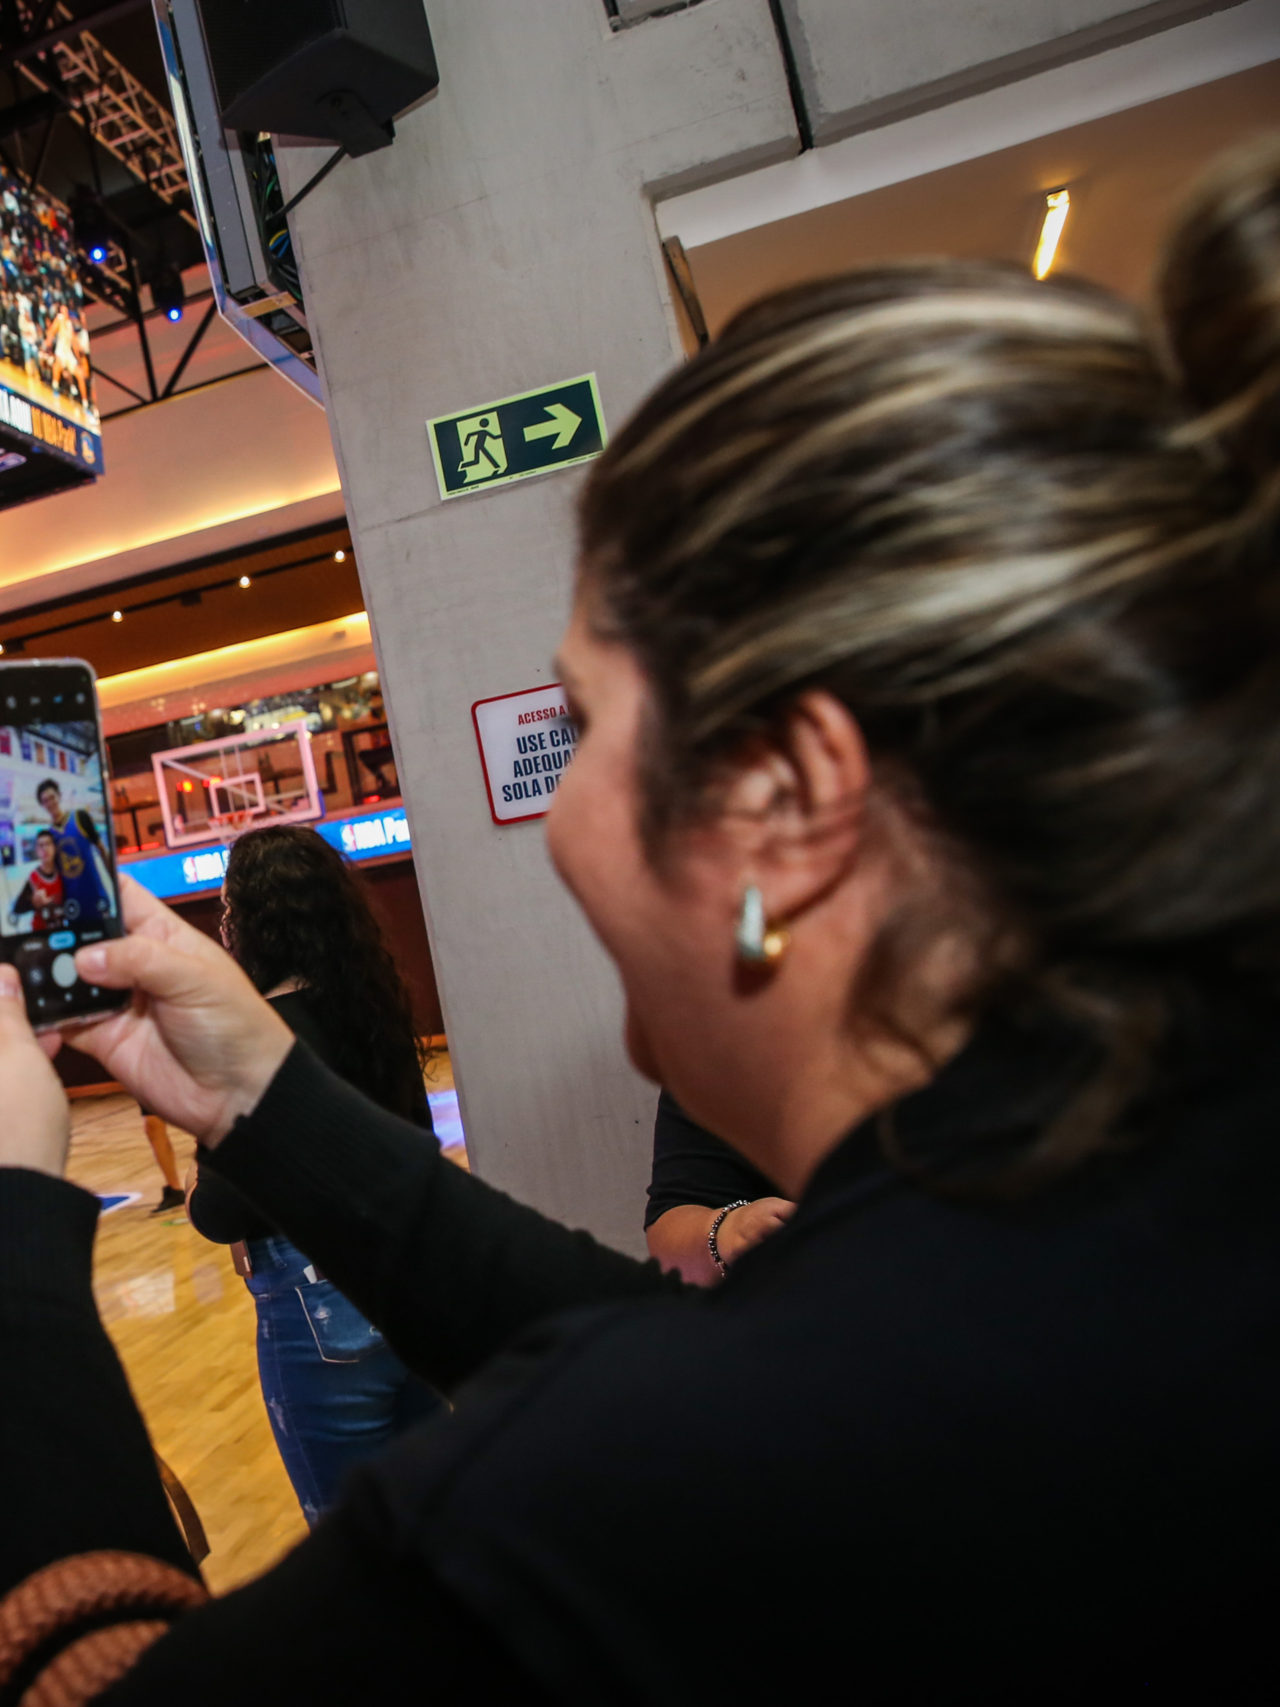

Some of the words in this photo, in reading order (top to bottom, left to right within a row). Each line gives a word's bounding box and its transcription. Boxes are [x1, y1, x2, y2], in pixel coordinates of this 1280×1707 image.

[517, 707, 557, 726] ACESSO
[516, 731, 547, 755] USE
[513, 748, 577, 779] ADEQUA
[502, 778, 542, 802] SOLA
